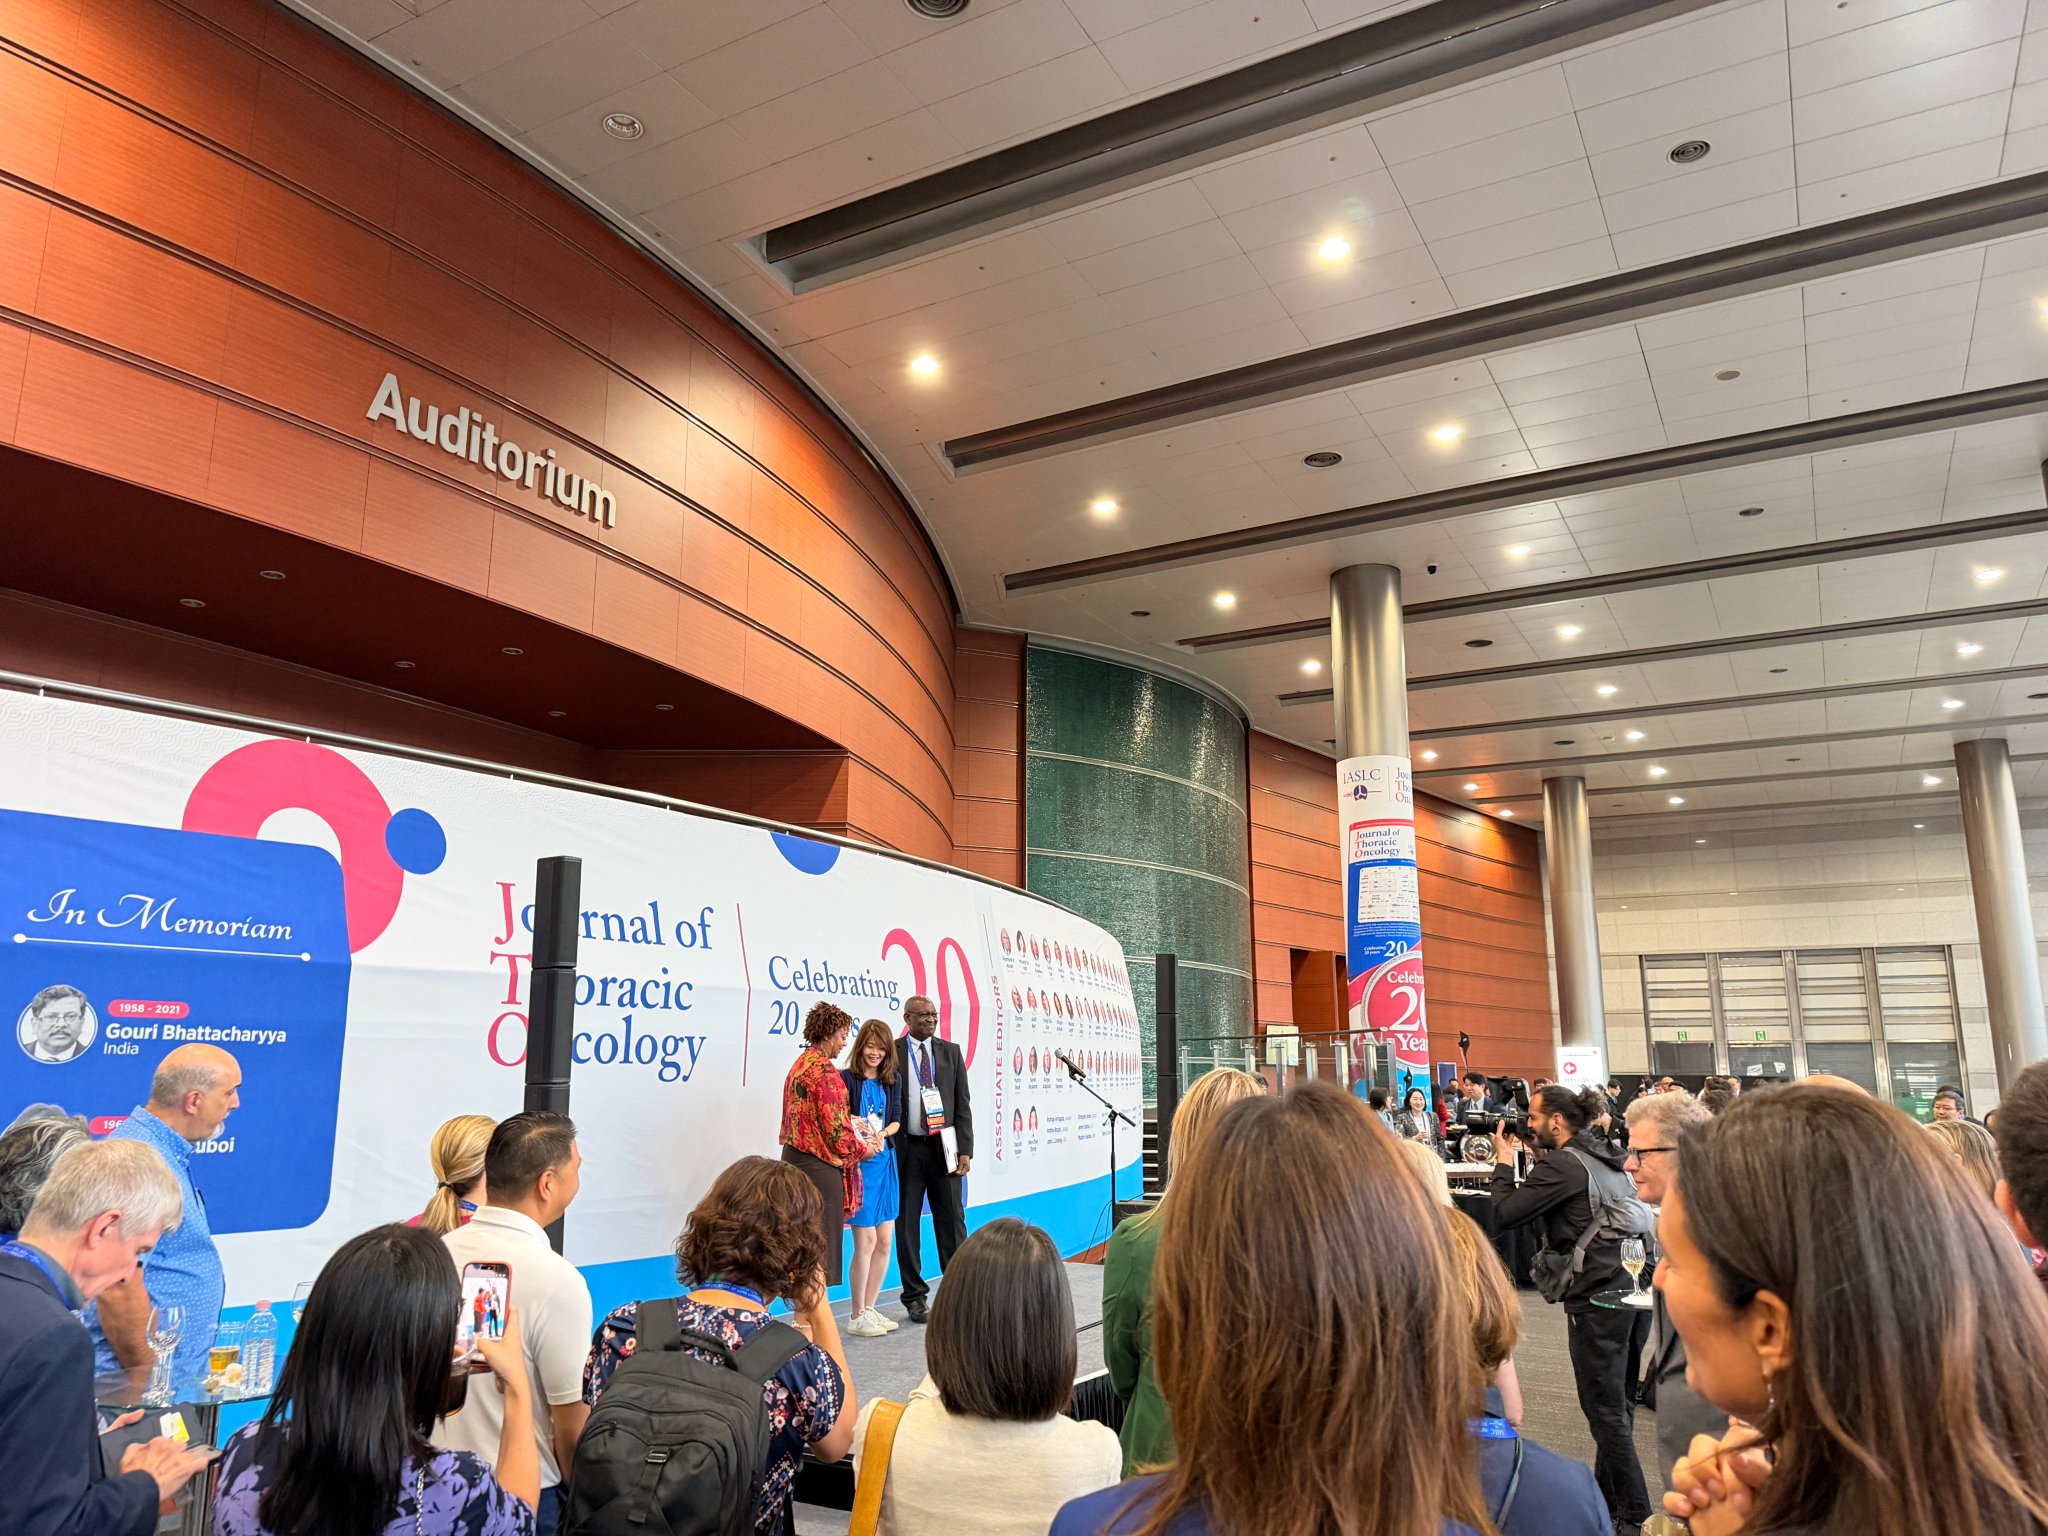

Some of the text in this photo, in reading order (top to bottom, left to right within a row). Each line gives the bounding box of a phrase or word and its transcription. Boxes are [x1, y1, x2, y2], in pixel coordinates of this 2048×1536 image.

[366, 372, 617, 529] Auditorium
[1343, 768, 1381, 785] IASLC
[1355, 837, 1397, 849] Thoracic
[1356, 828, 1391, 841] Journal
[1355, 847, 1401, 858] Oncology
[27, 888, 293, 941] In Memoriam
[494, 881, 715, 950] Jornal of
[1383, 940, 1408, 957] 20
[490, 950, 694, 1012] Toracic
[768, 955, 901, 1011] Celebrating
[119, 1003, 145, 1013] 1958
[155, 1004, 181, 1015] 2021
[768, 1000, 799, 1035] 20
[105, 1023, 287, 1045] Gouri Bhattacharyya
[487, 1012, 708, 1083] Ocology
[103, 1042, 139, 1055] India
[991, 975, 1004, 1162] ASSOCIATE EDITORS
